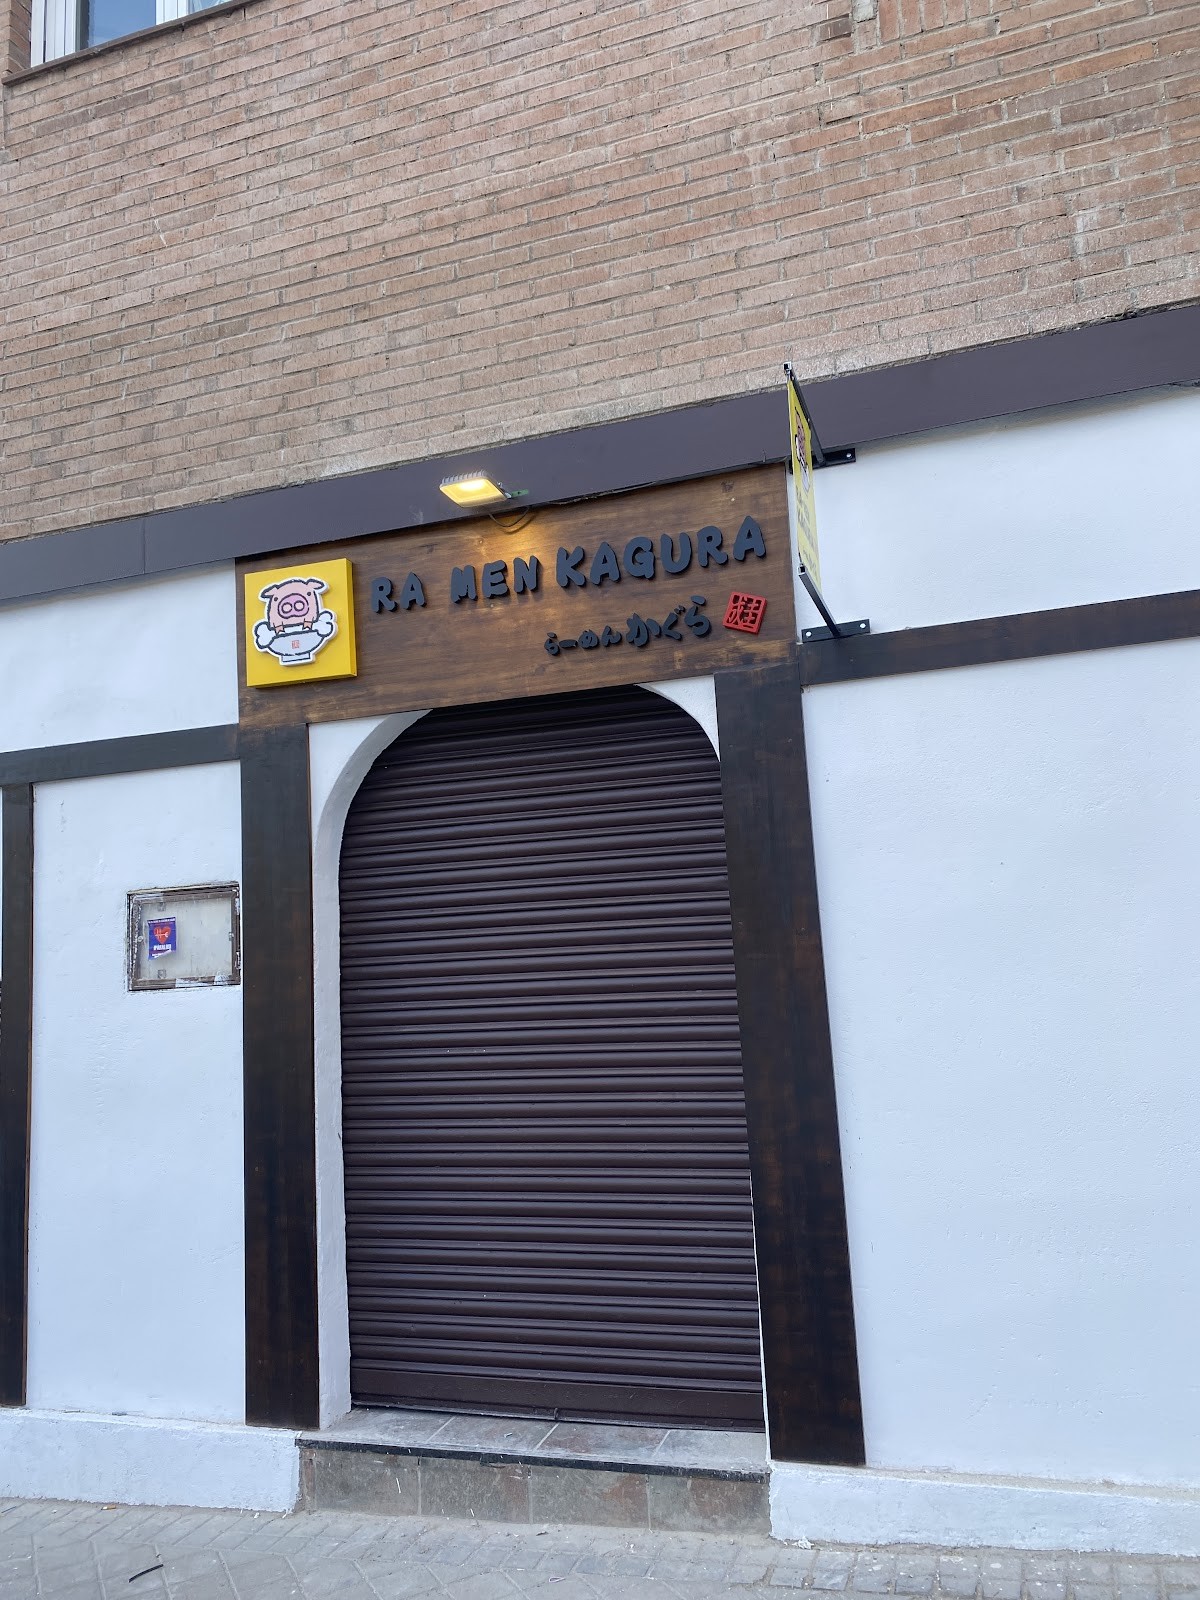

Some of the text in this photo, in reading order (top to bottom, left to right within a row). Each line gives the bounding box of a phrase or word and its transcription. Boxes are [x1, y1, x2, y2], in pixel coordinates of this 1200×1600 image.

[371, 572, 426, 614] RA
[450, 555, 540, 604] MEN
[556, 515, 766, 588] KAGURA
